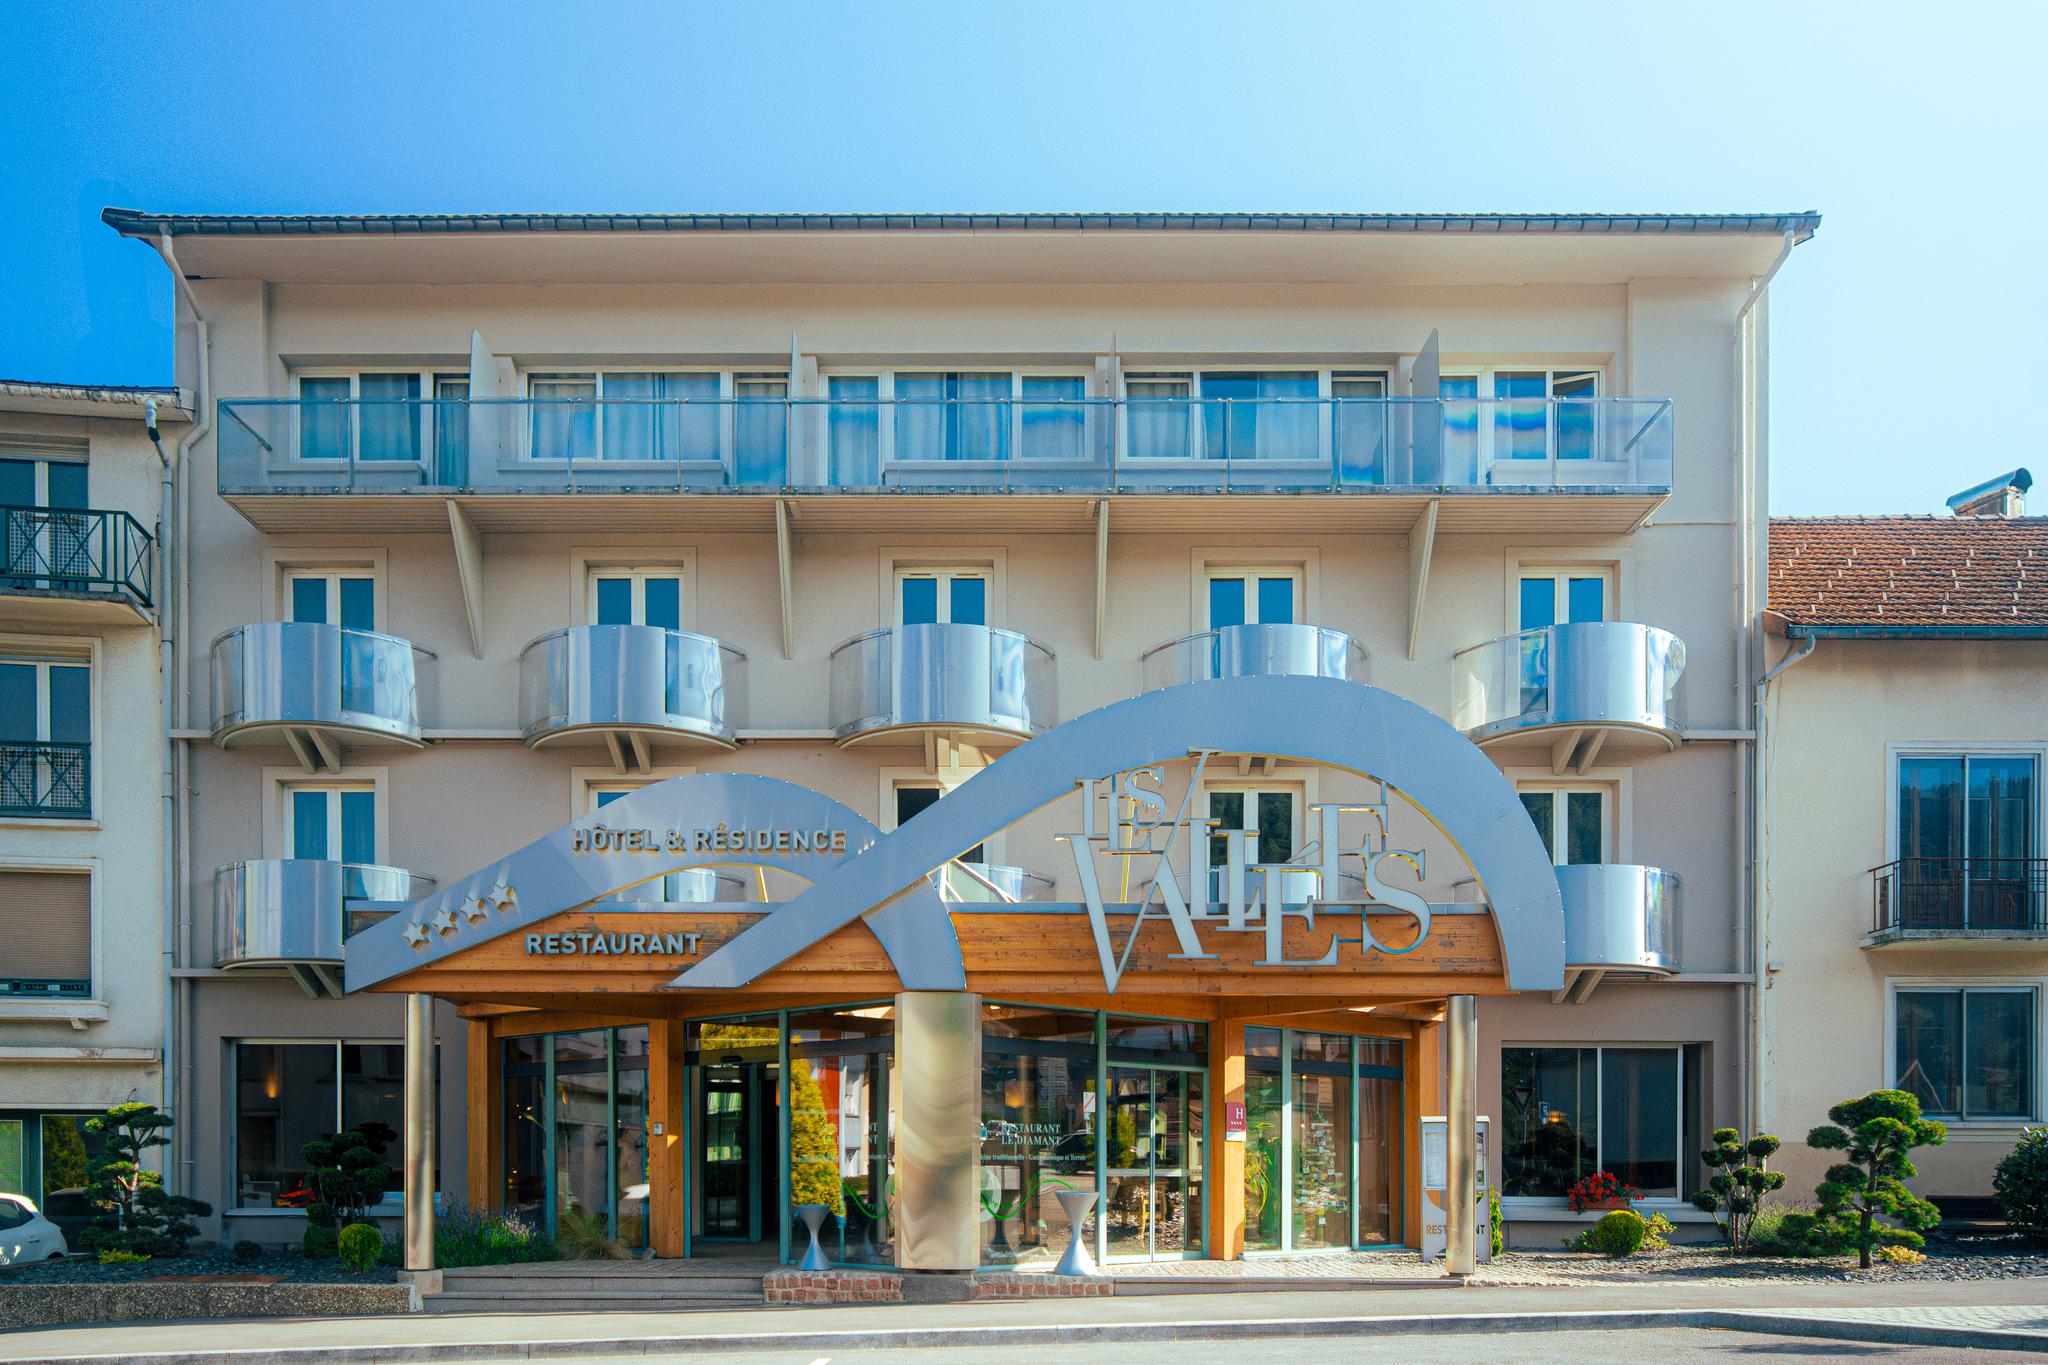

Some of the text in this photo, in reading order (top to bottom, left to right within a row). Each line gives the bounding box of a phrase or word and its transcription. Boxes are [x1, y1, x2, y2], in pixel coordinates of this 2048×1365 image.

[571, 823, 847, 853] HÔTEL & RÉSIDENCE
[525, 933, 701, 955] RESTAURANT
[1235, 1107, 1244, 1119] H
[1001, 1123, 1060, 1134] RESTAURANT
[1001, 1136, 1061, 1145] LE DIAMANT
